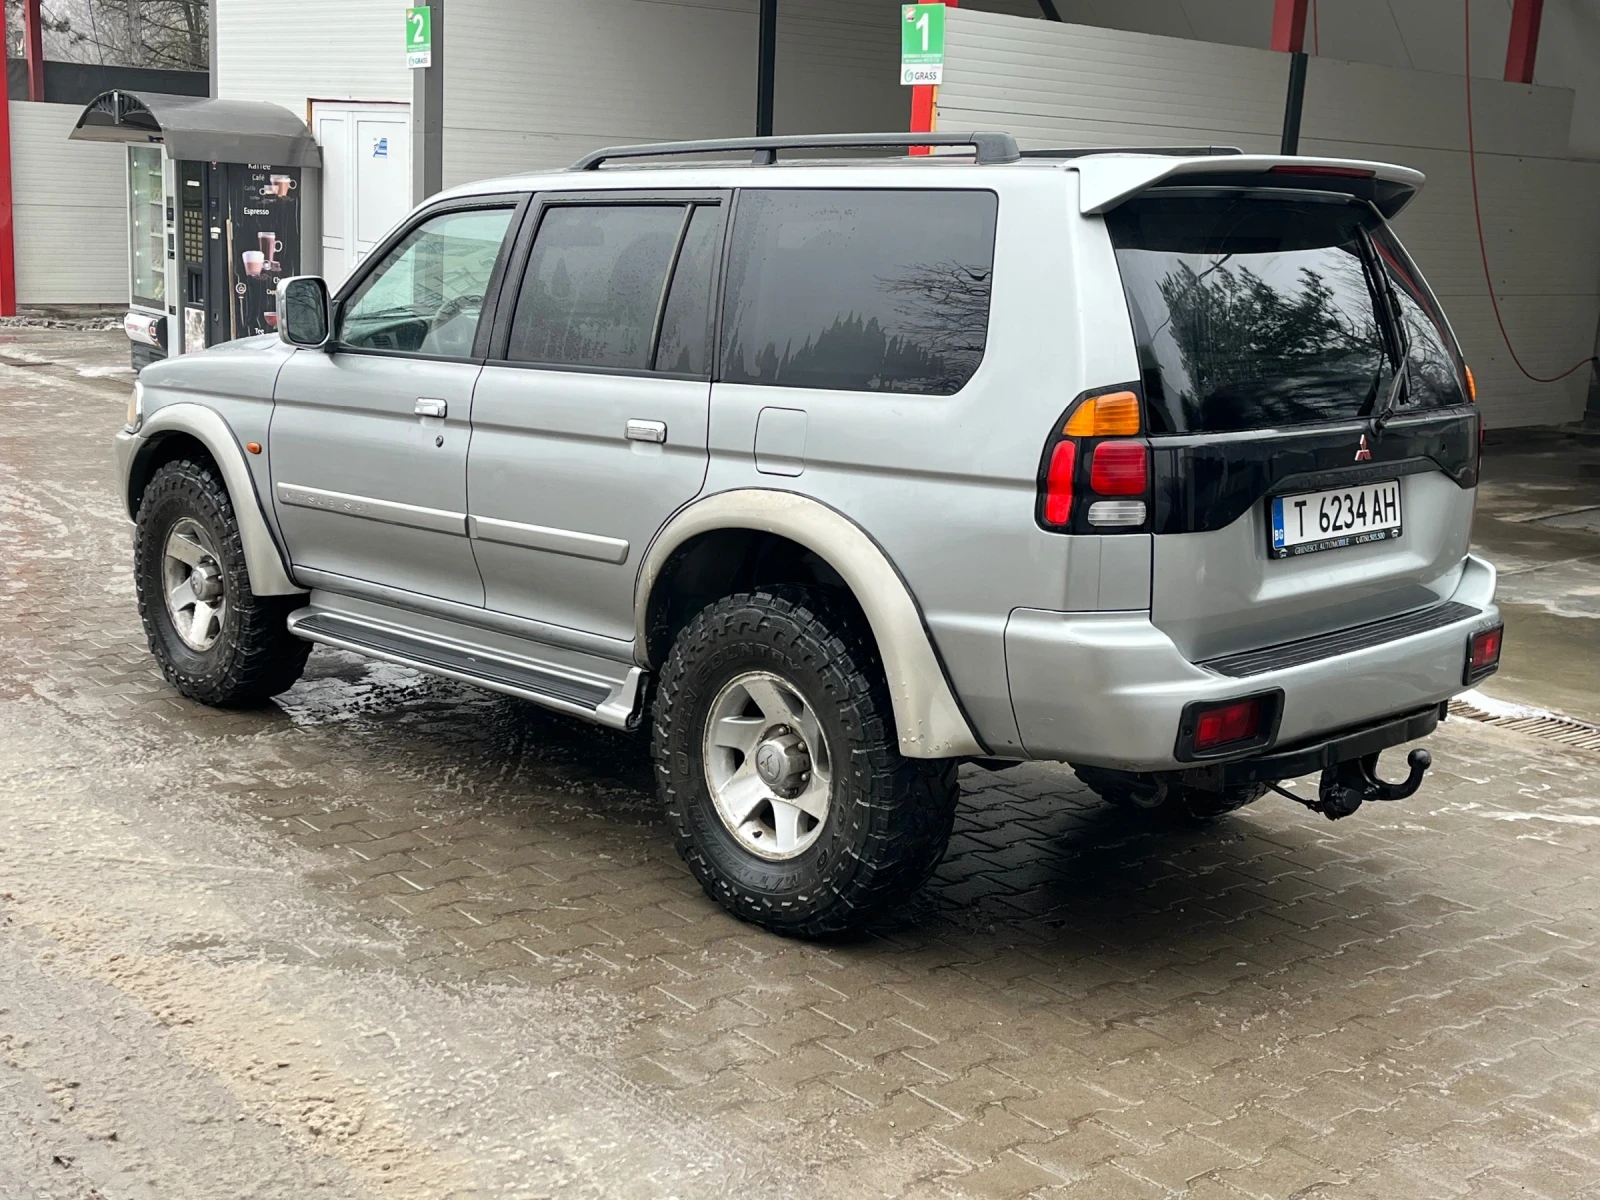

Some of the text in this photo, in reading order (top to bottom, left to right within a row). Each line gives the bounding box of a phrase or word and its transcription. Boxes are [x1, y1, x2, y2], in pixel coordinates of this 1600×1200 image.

[413, 14, 424, 43] 2
[916, 13, 929, 51] 1
[915, 72, 937, 80] GRASS
[243, 207, 270, 216] Espresso
[1294, 487, 1397, 537] T 6234 AH
[1274, 529, 1284, 541] BG
[698, 641, 802, 684] COUNTRY
